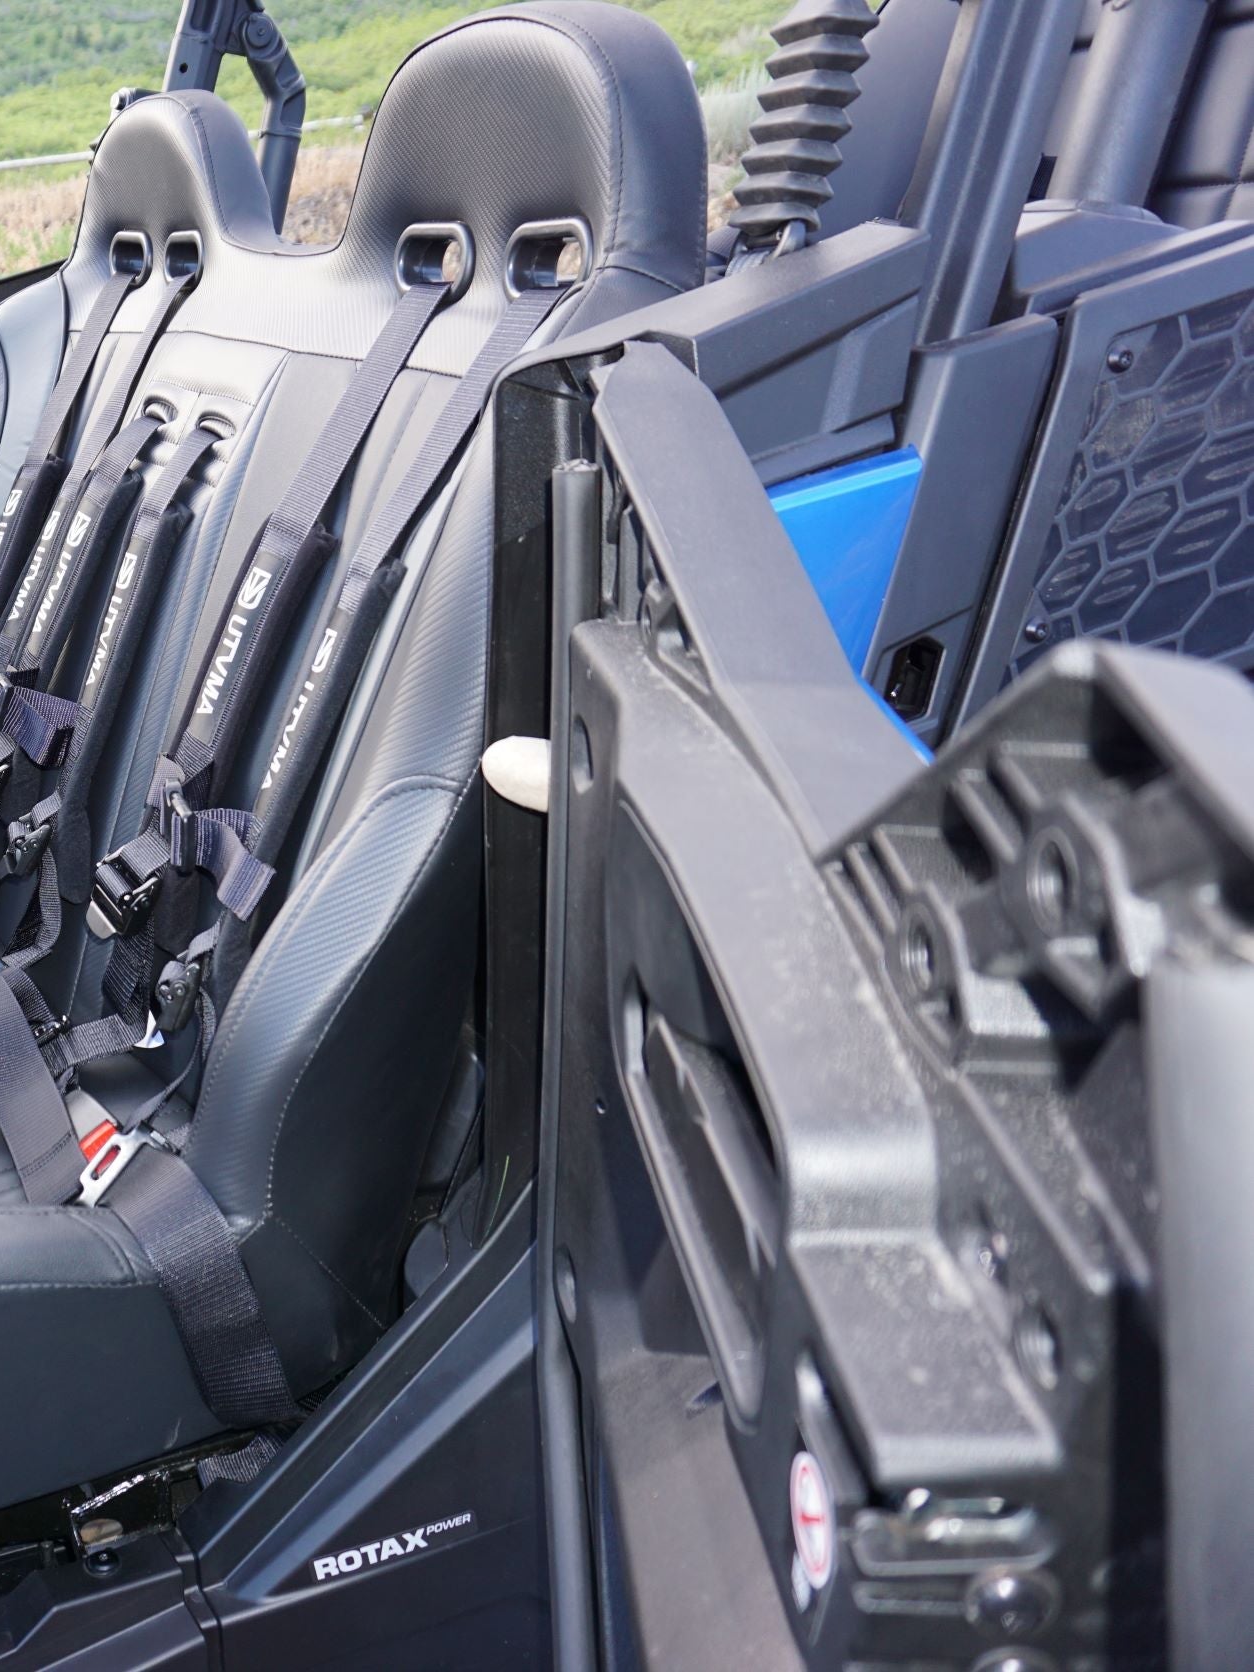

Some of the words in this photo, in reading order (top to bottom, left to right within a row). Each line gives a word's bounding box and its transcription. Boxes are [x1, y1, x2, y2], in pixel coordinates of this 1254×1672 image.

[32, 551, 72, 633] UTVMA
[86, 595, 123, 686] UTVMA
[196, 614, 248, 715] UTVMA
[313, 1528, 429, 1581] ROTAX
[426, 1512, 472, 1537] POWER
